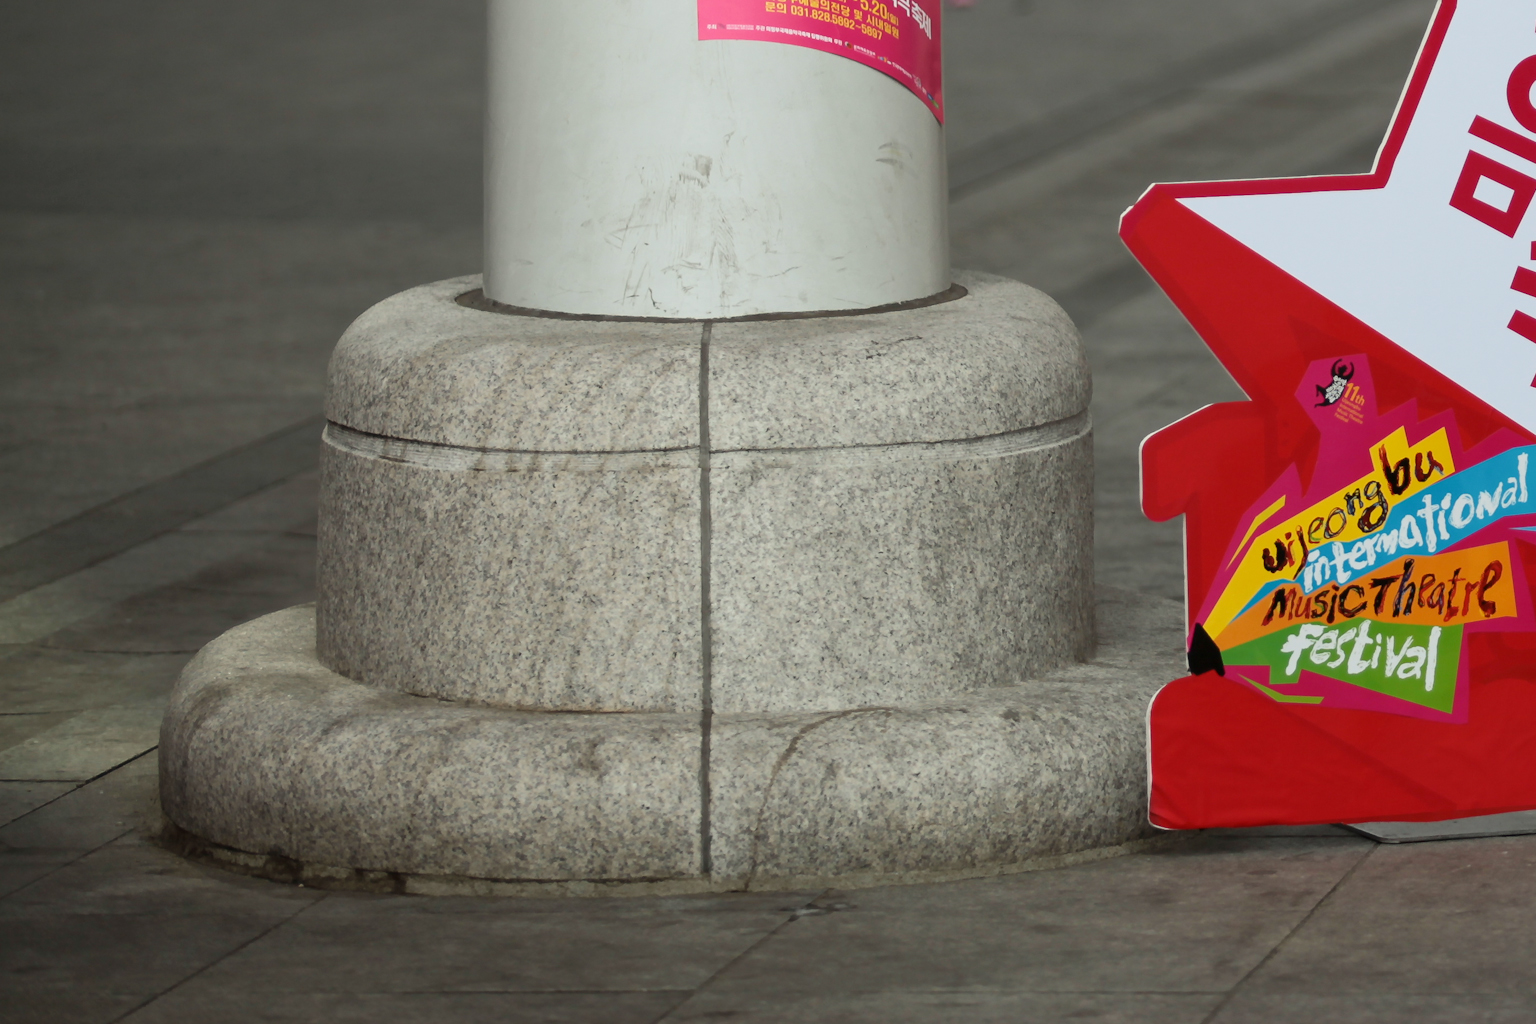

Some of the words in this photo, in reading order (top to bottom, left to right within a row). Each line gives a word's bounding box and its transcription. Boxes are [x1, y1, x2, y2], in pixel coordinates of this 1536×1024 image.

[765, 1, 787, 14] 문의
[911, 0, 932, 40] 축제
[1344, 382, 1365, 406] 11th
